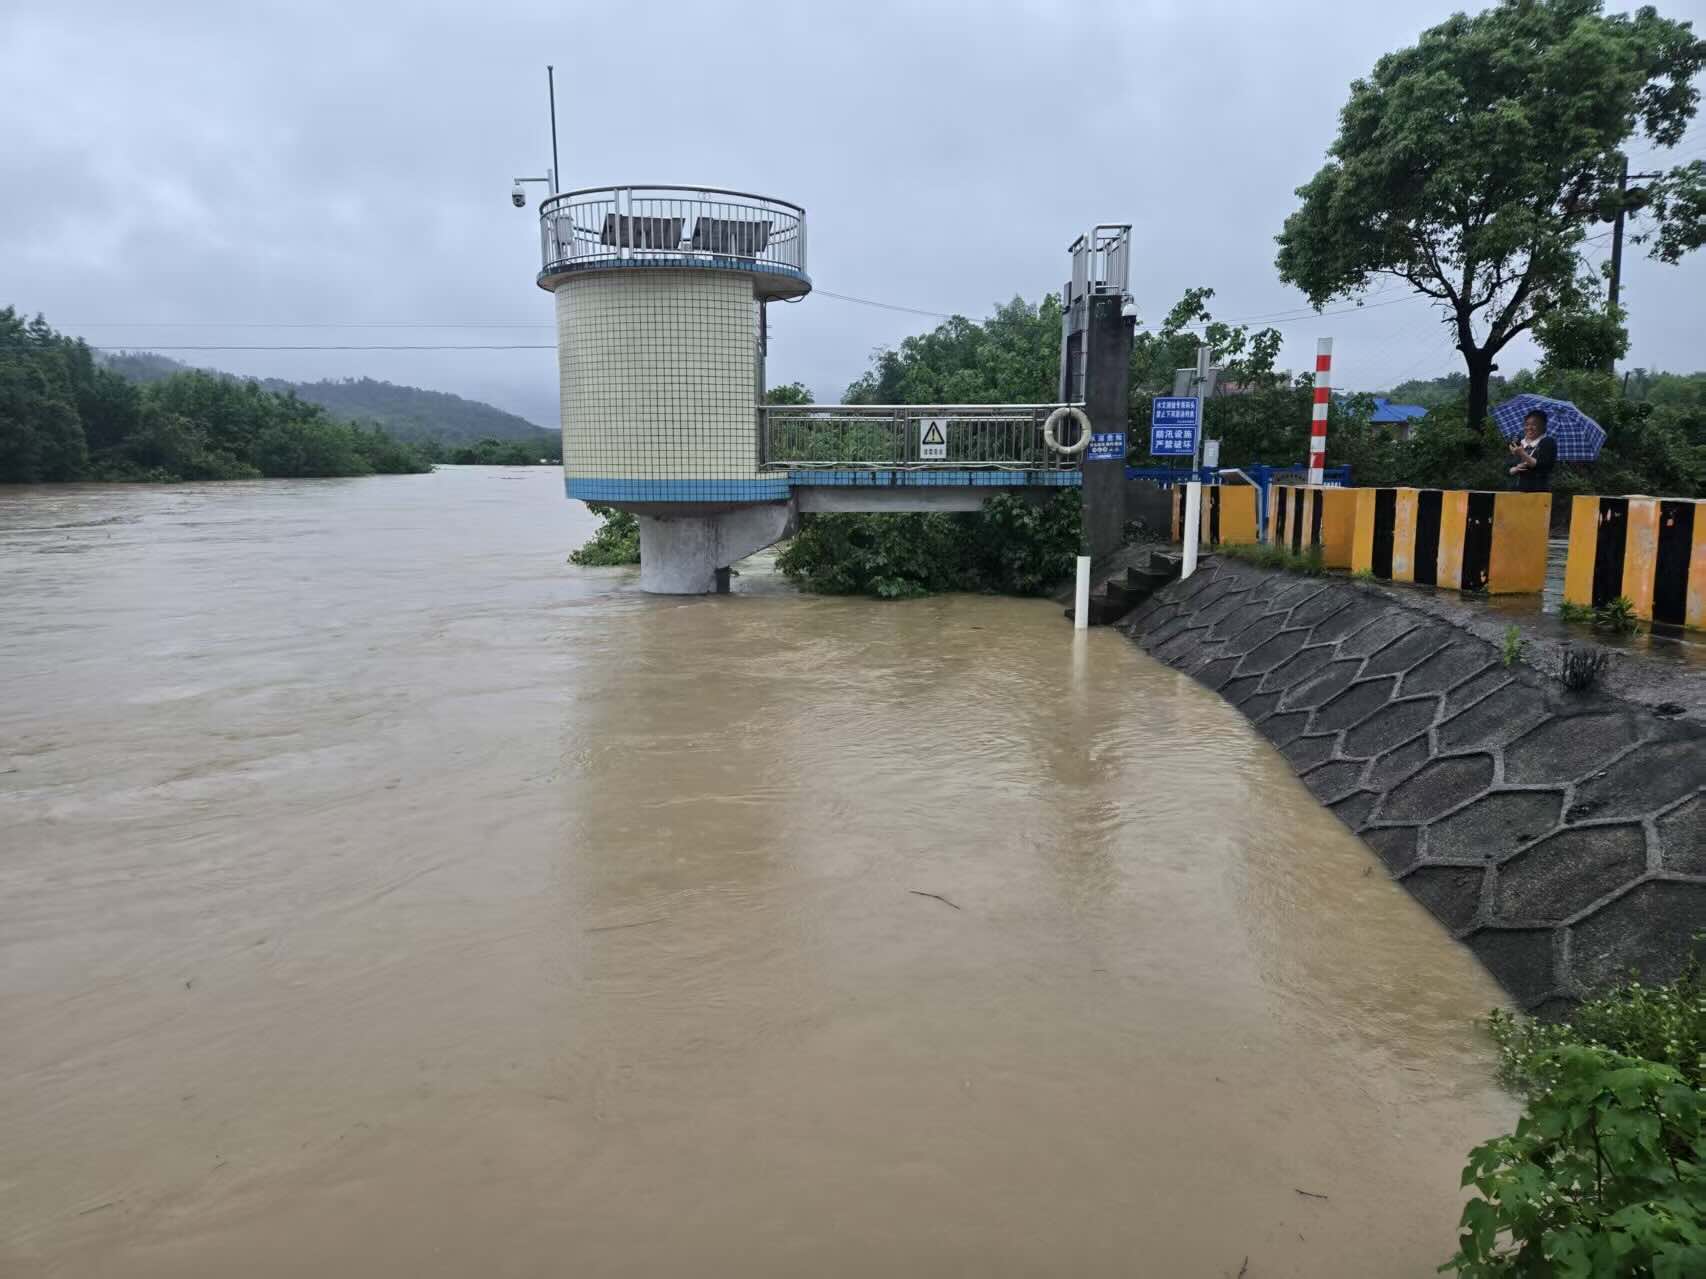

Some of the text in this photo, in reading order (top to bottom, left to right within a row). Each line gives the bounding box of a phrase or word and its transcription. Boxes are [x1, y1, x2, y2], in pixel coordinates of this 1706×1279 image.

[1155, 430, 1192, 439] 防汛设施
[1155, 440, 1192, 449] 严禁破坏
